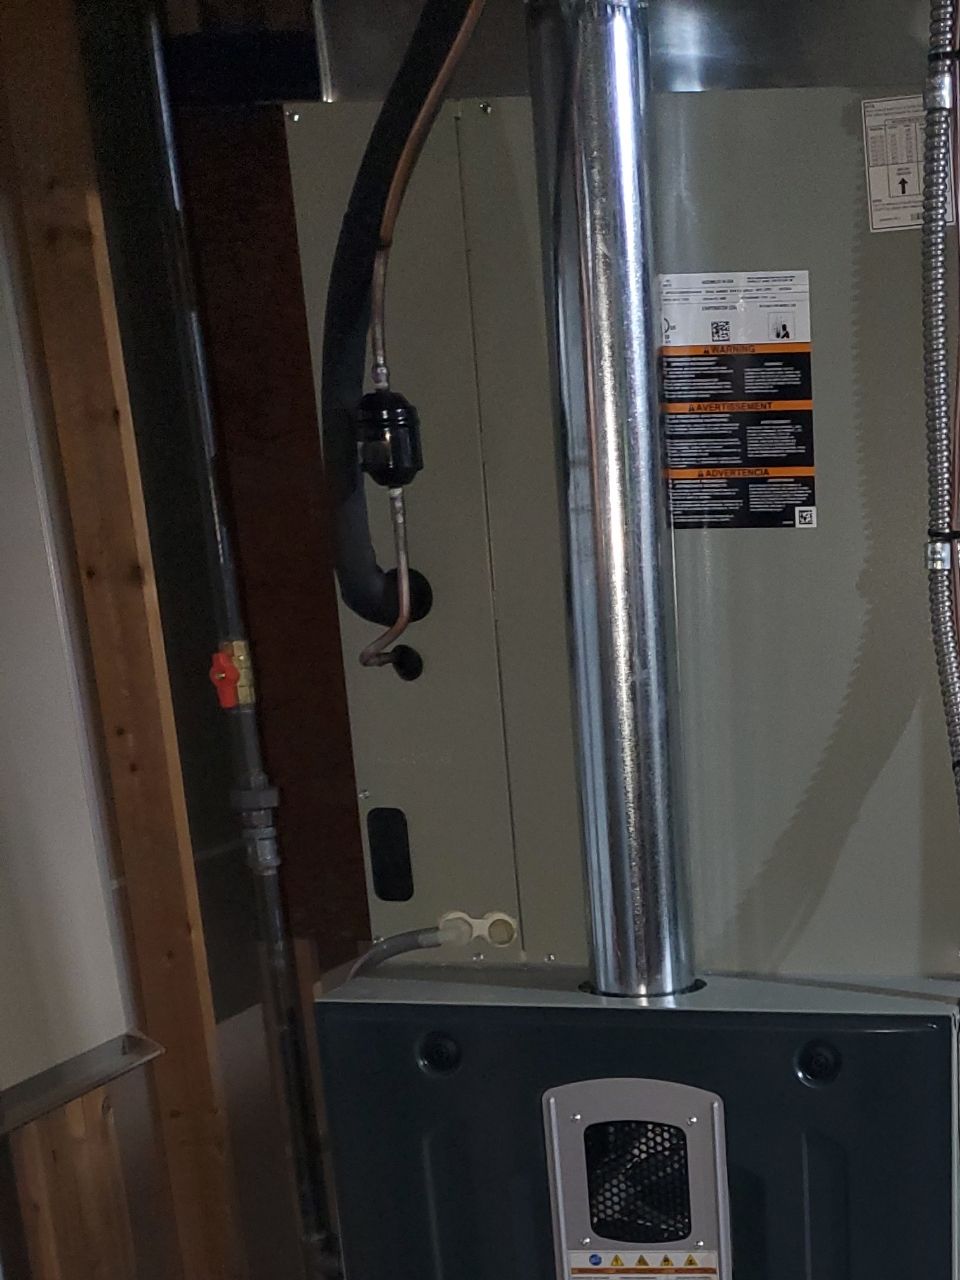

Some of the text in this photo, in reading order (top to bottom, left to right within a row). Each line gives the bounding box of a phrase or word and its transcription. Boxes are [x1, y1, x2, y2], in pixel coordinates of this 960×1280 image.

[711, 345, 756, 353] WARNING
[697, 402, 773, 411] AVERTISSEMENT
[705, 469, 770, 477] ADVERTENCIA
